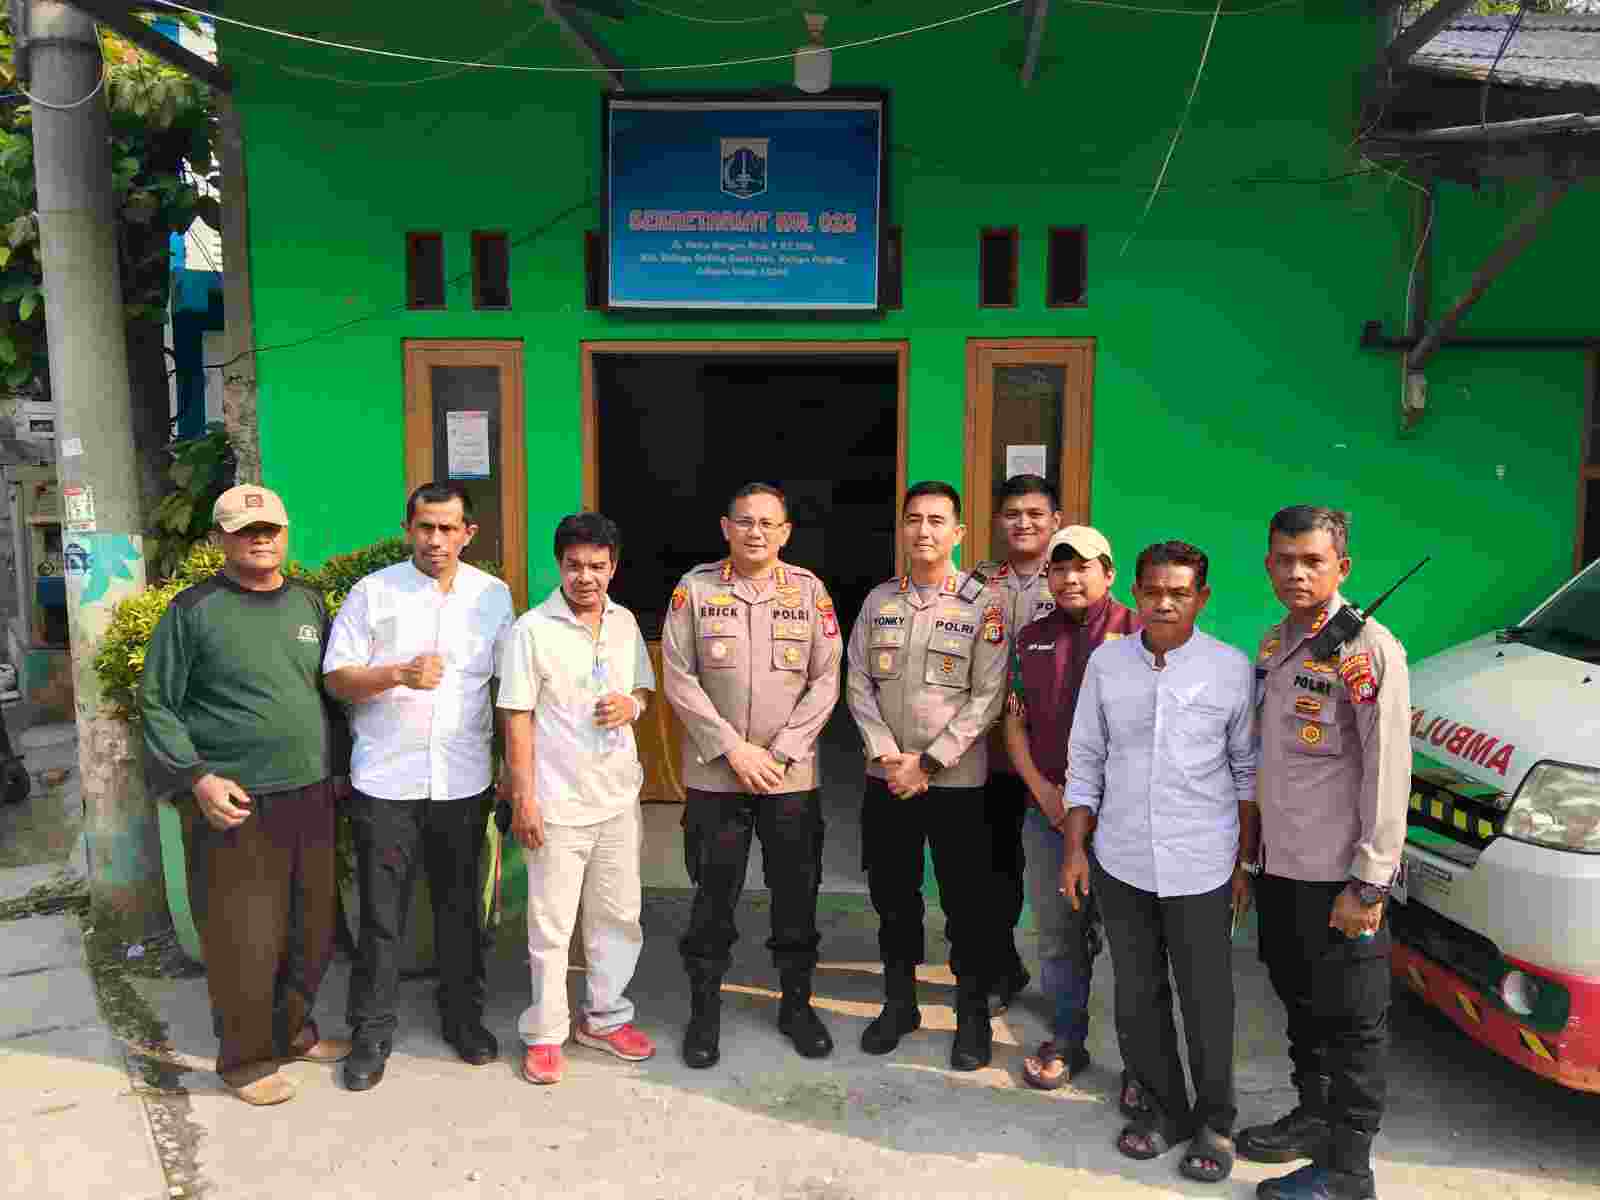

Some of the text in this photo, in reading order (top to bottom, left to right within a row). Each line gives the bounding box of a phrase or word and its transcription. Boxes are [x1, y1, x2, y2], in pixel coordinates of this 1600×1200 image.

[700, 607, 738, 617] ERICK
[773, 609, 809, 621] POLRI
[935, 620, 975, 634] POLRI
